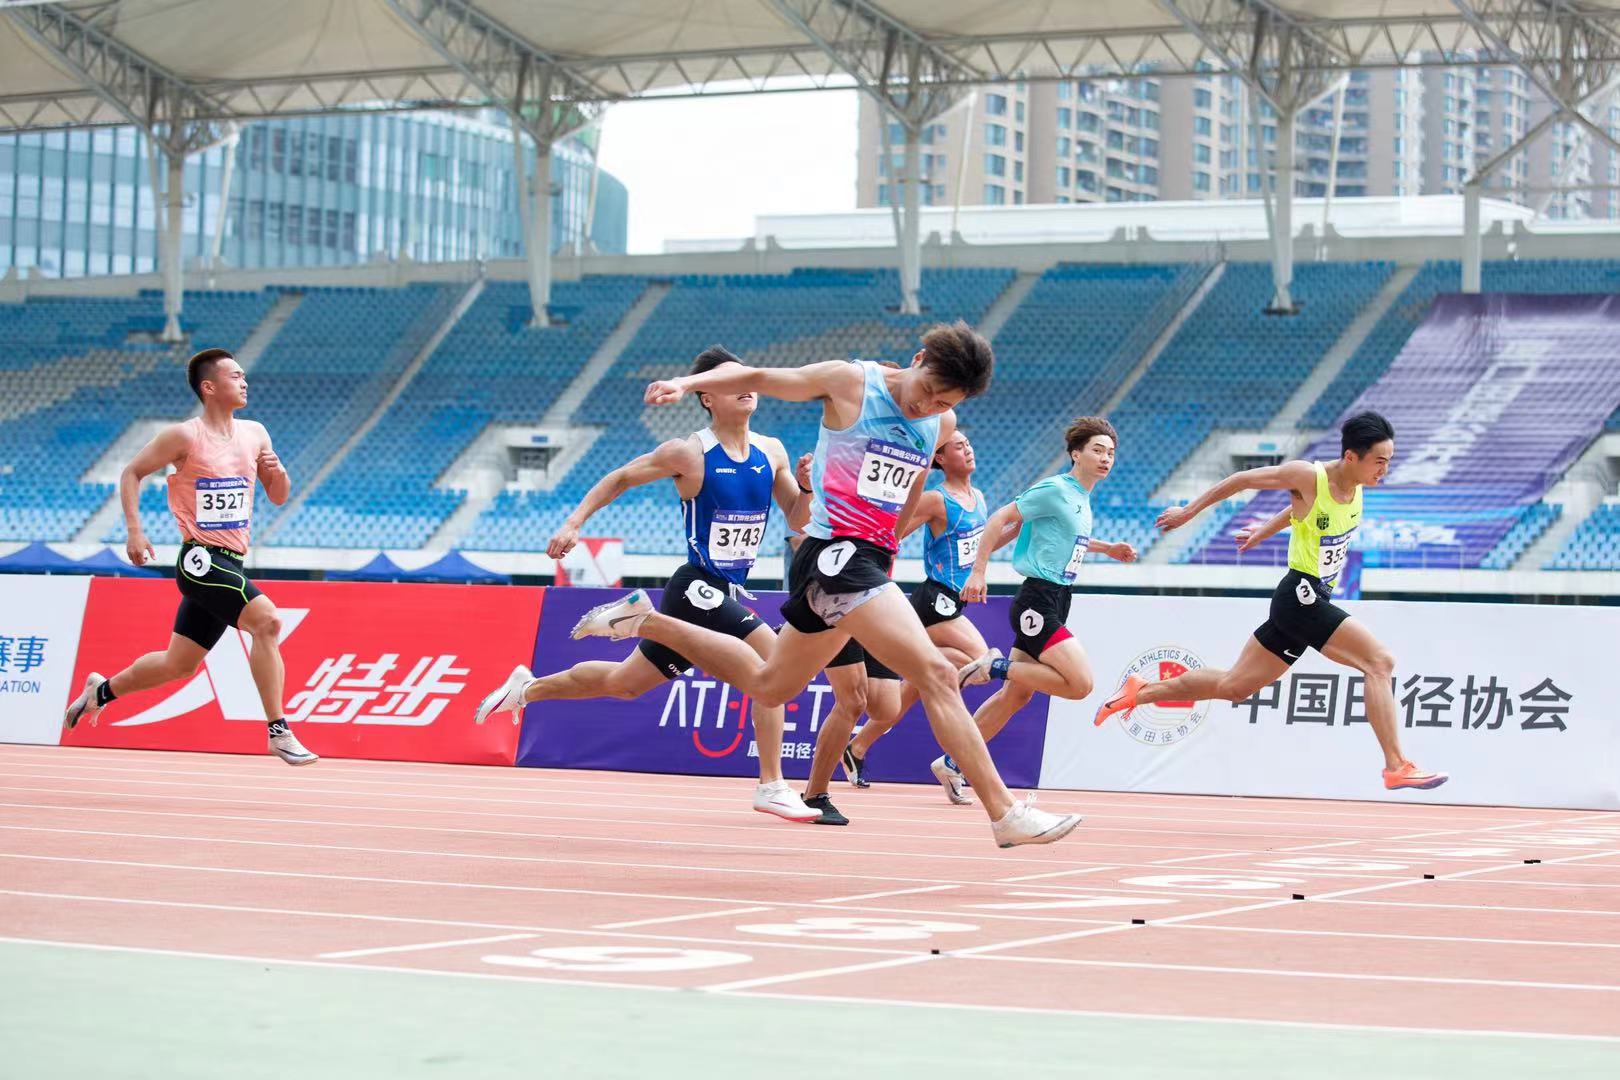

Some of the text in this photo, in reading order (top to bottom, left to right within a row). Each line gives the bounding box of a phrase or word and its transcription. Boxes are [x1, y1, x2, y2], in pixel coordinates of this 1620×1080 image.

[867, 460, 916, 489] 3701
[203, 492, 245, 510] 3527
[716, 528, 760, 547] 3743
[191, 554, 203, 571] 5
[832, 548, 844, 566] 7
[698, 585, 714, 600] 6
[1300, 585, 1310, 598] 3
[940, 597, 950, 609] 1
[1025, 615, 1037, 630] 2
[1140, 649, 1181, 668] ATHLETICS
[283, 653, 470, 726] 特步
[1251, 857, 1432, 871] 5
[1117, 874, 1307, 890] 6
[955, 892, 1181, 909] 7
[735, 917, 981, 940] 8
[480, 946, 753, 972] 9
